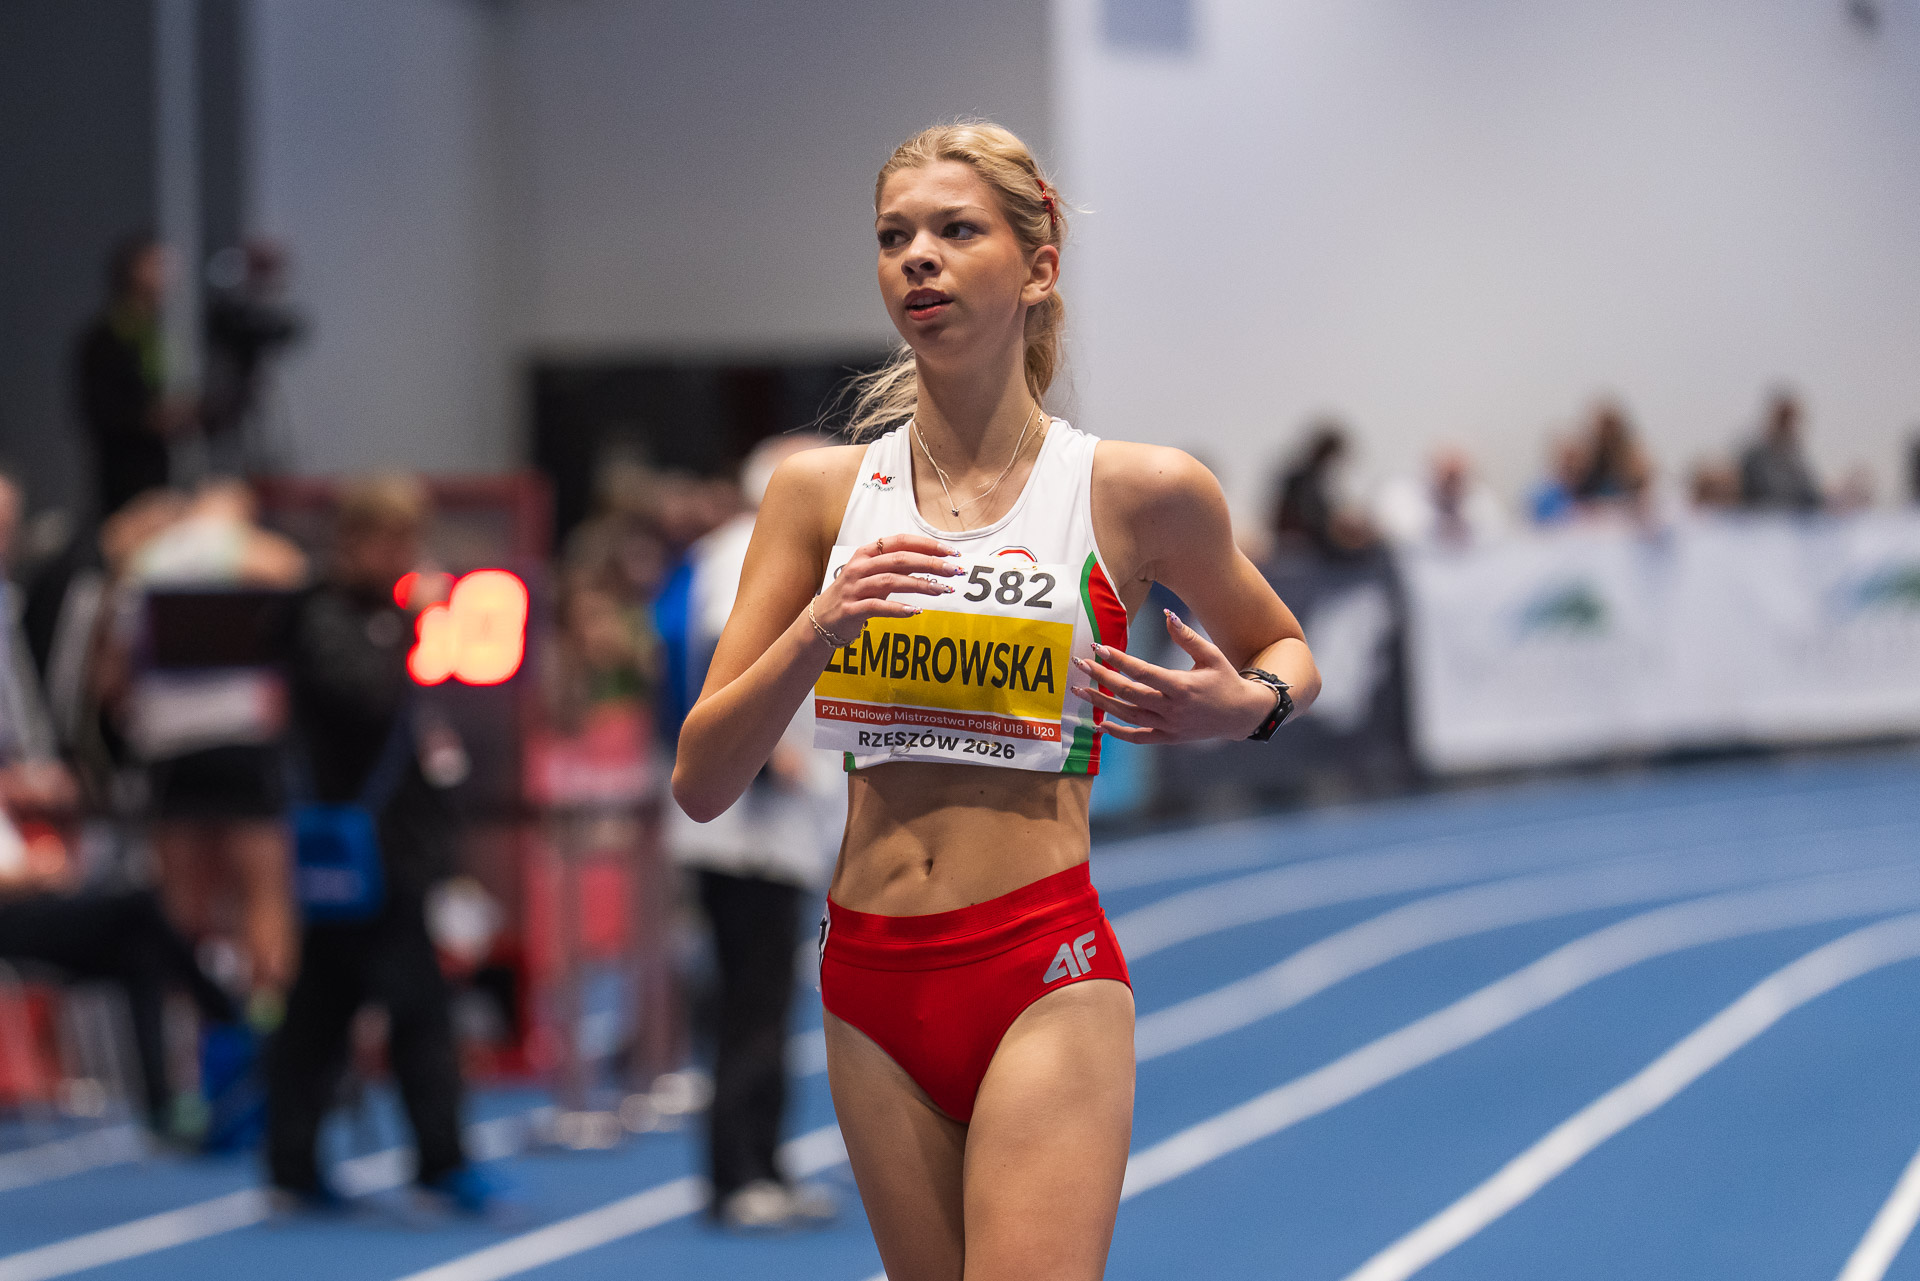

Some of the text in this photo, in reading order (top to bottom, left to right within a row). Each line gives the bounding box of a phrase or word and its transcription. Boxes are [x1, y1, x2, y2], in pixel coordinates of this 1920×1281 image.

[963, 565, 1056, 609] 582
[822, 705, 848, 717] PZLA
[850, 708, 892, 721] Halowe
[895, 711, 965, 727] Mistrzostwa
[968, 719, 1001, 732] Polski
[1004, 723, 1024, 735] U18
[1033, 726, 1055, 737] U20
[858, 729, 1015, 760] RZESZÓW 2026
